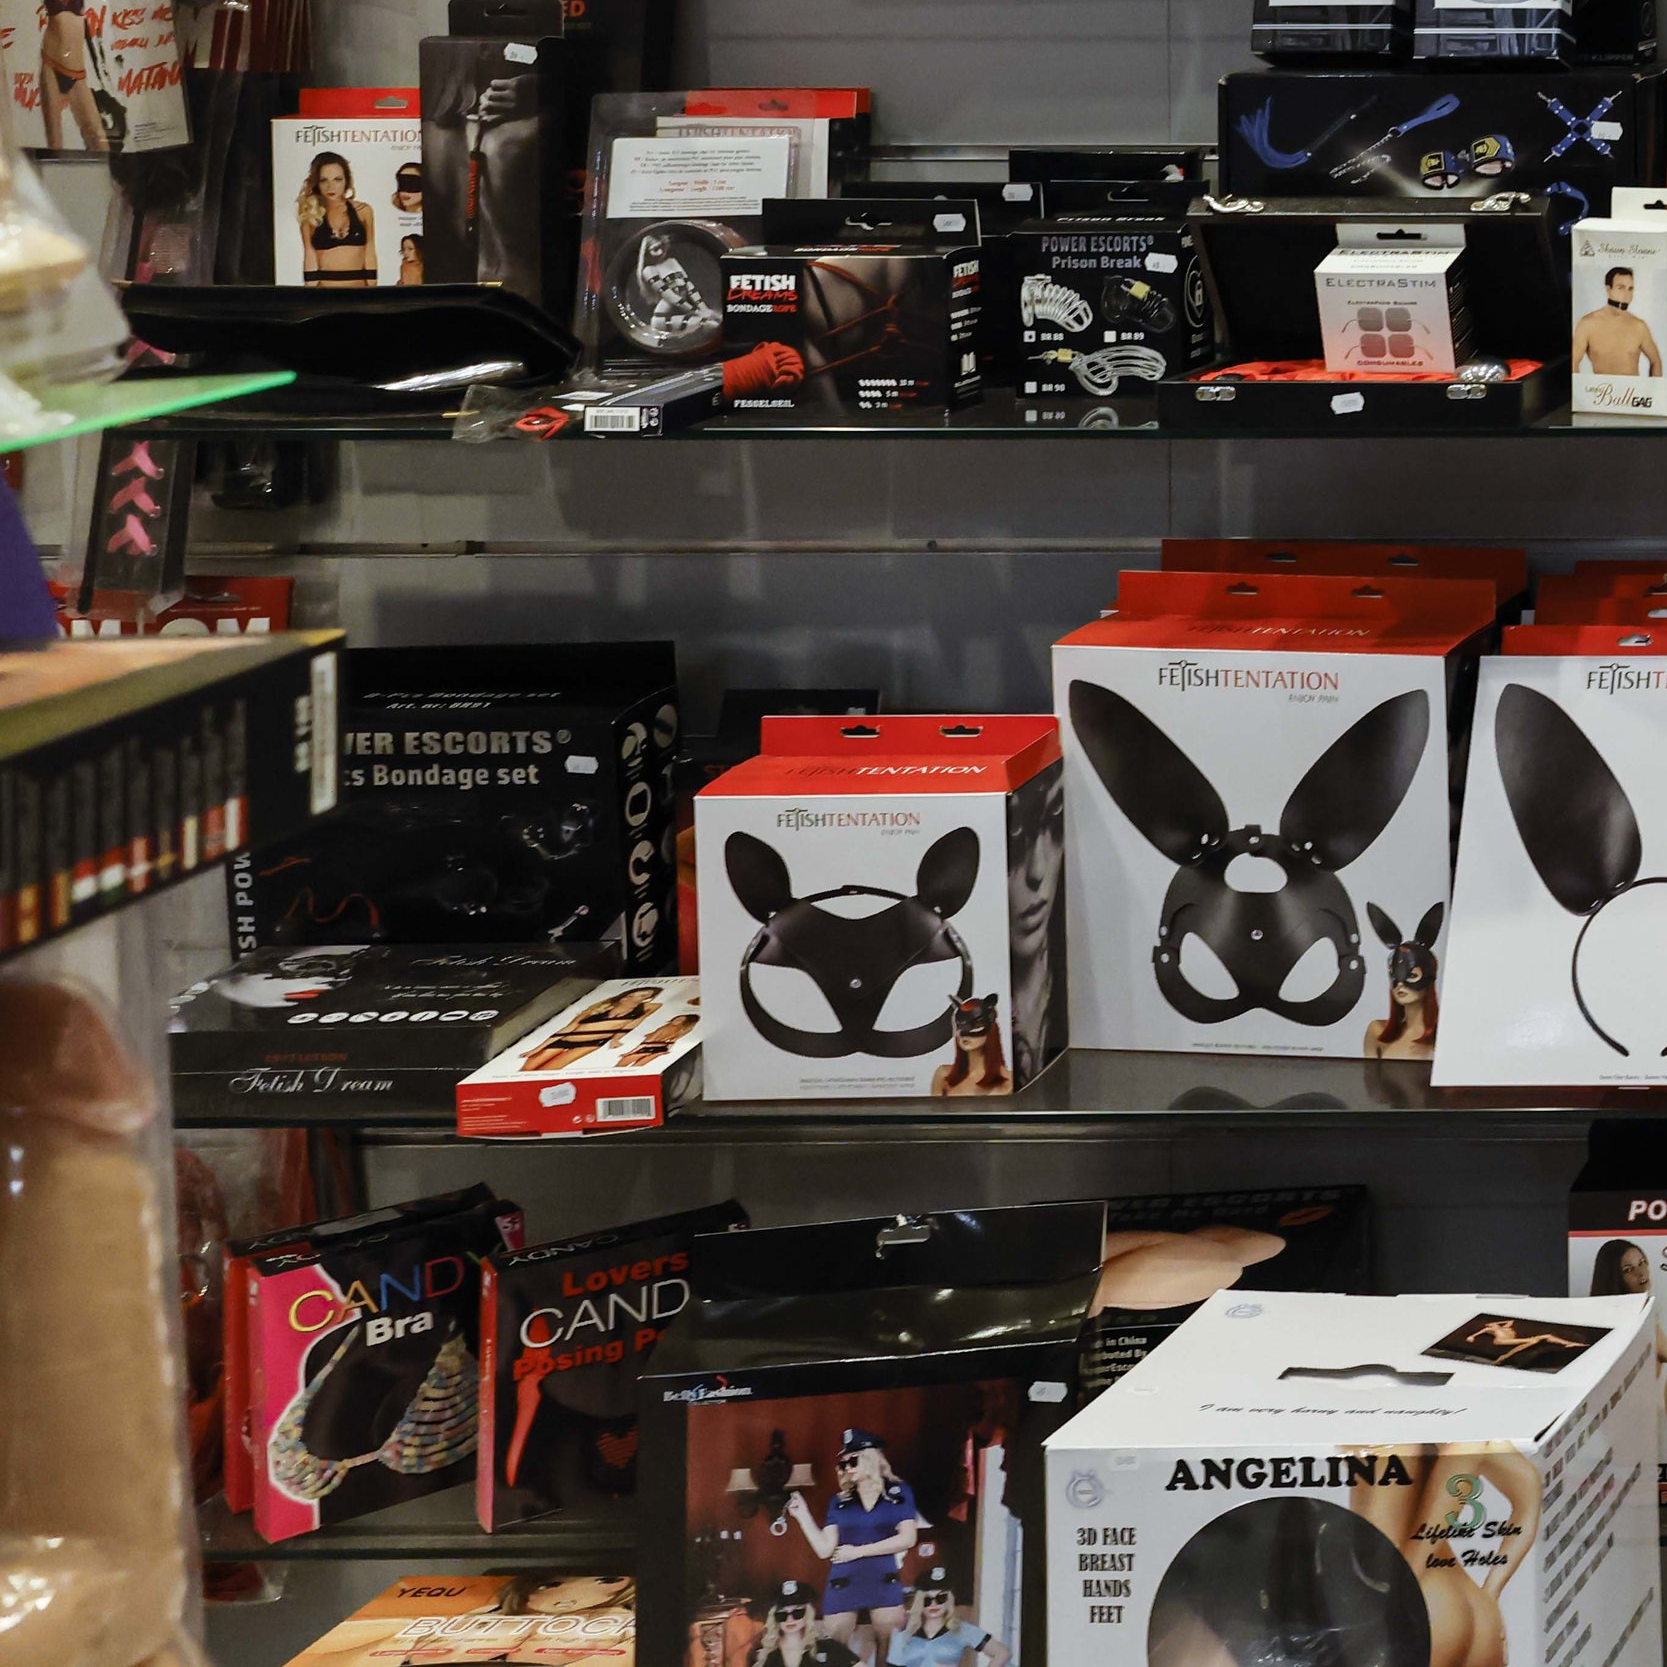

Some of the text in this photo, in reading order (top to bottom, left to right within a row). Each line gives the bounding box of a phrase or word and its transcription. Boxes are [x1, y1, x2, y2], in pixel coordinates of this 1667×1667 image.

[1041, 235, 1088, 253] POWER
[1052, 255, 1142, 269] Prison Break
[729, 273, 797, 290] FETISH
[727, 287, 798, 302] DREAMS
[734, 399, 795, 408] FESSELSEIL
[1593, 382, 1653, 409] Ball GAG
[1158, 659, 1340, 691] FETISHTENTATION
[372, 763, 541, 791] Bondage set
[777, 807, 921, 832] FETISHTENTATION
[229, 1066, 394, 1094] Fetish Dream
[562, 1250, 690, 1298] Lovers
[519, 1278, 691, 1349] CAND
[366, 1309, 435, 1347] Bra
[513, 1339, 624, 1382] Posing
[1248, 1407, 1286, 1415] very
[1291, 1406, 1339, 1415] horny
[1344, 1407, 1376, 1415] and
[1165, 1455, 1414, 1491] ANGELINA
[1445, 1473, 1487, 1531] 3
[1076, 1527, 1137, 1545] 3D FACE
[1482, 1521, 1523, 1540] Skin
[1078, 1553, 1136, 1572] BREAST
[1425, 1550, 1508, 1569] love Holes
[398, 1586, 468, 1599] YEQU
[1082, 1578, 1132, 1598] HANDS
[1089, 1604, 1125, 1624] FEET
